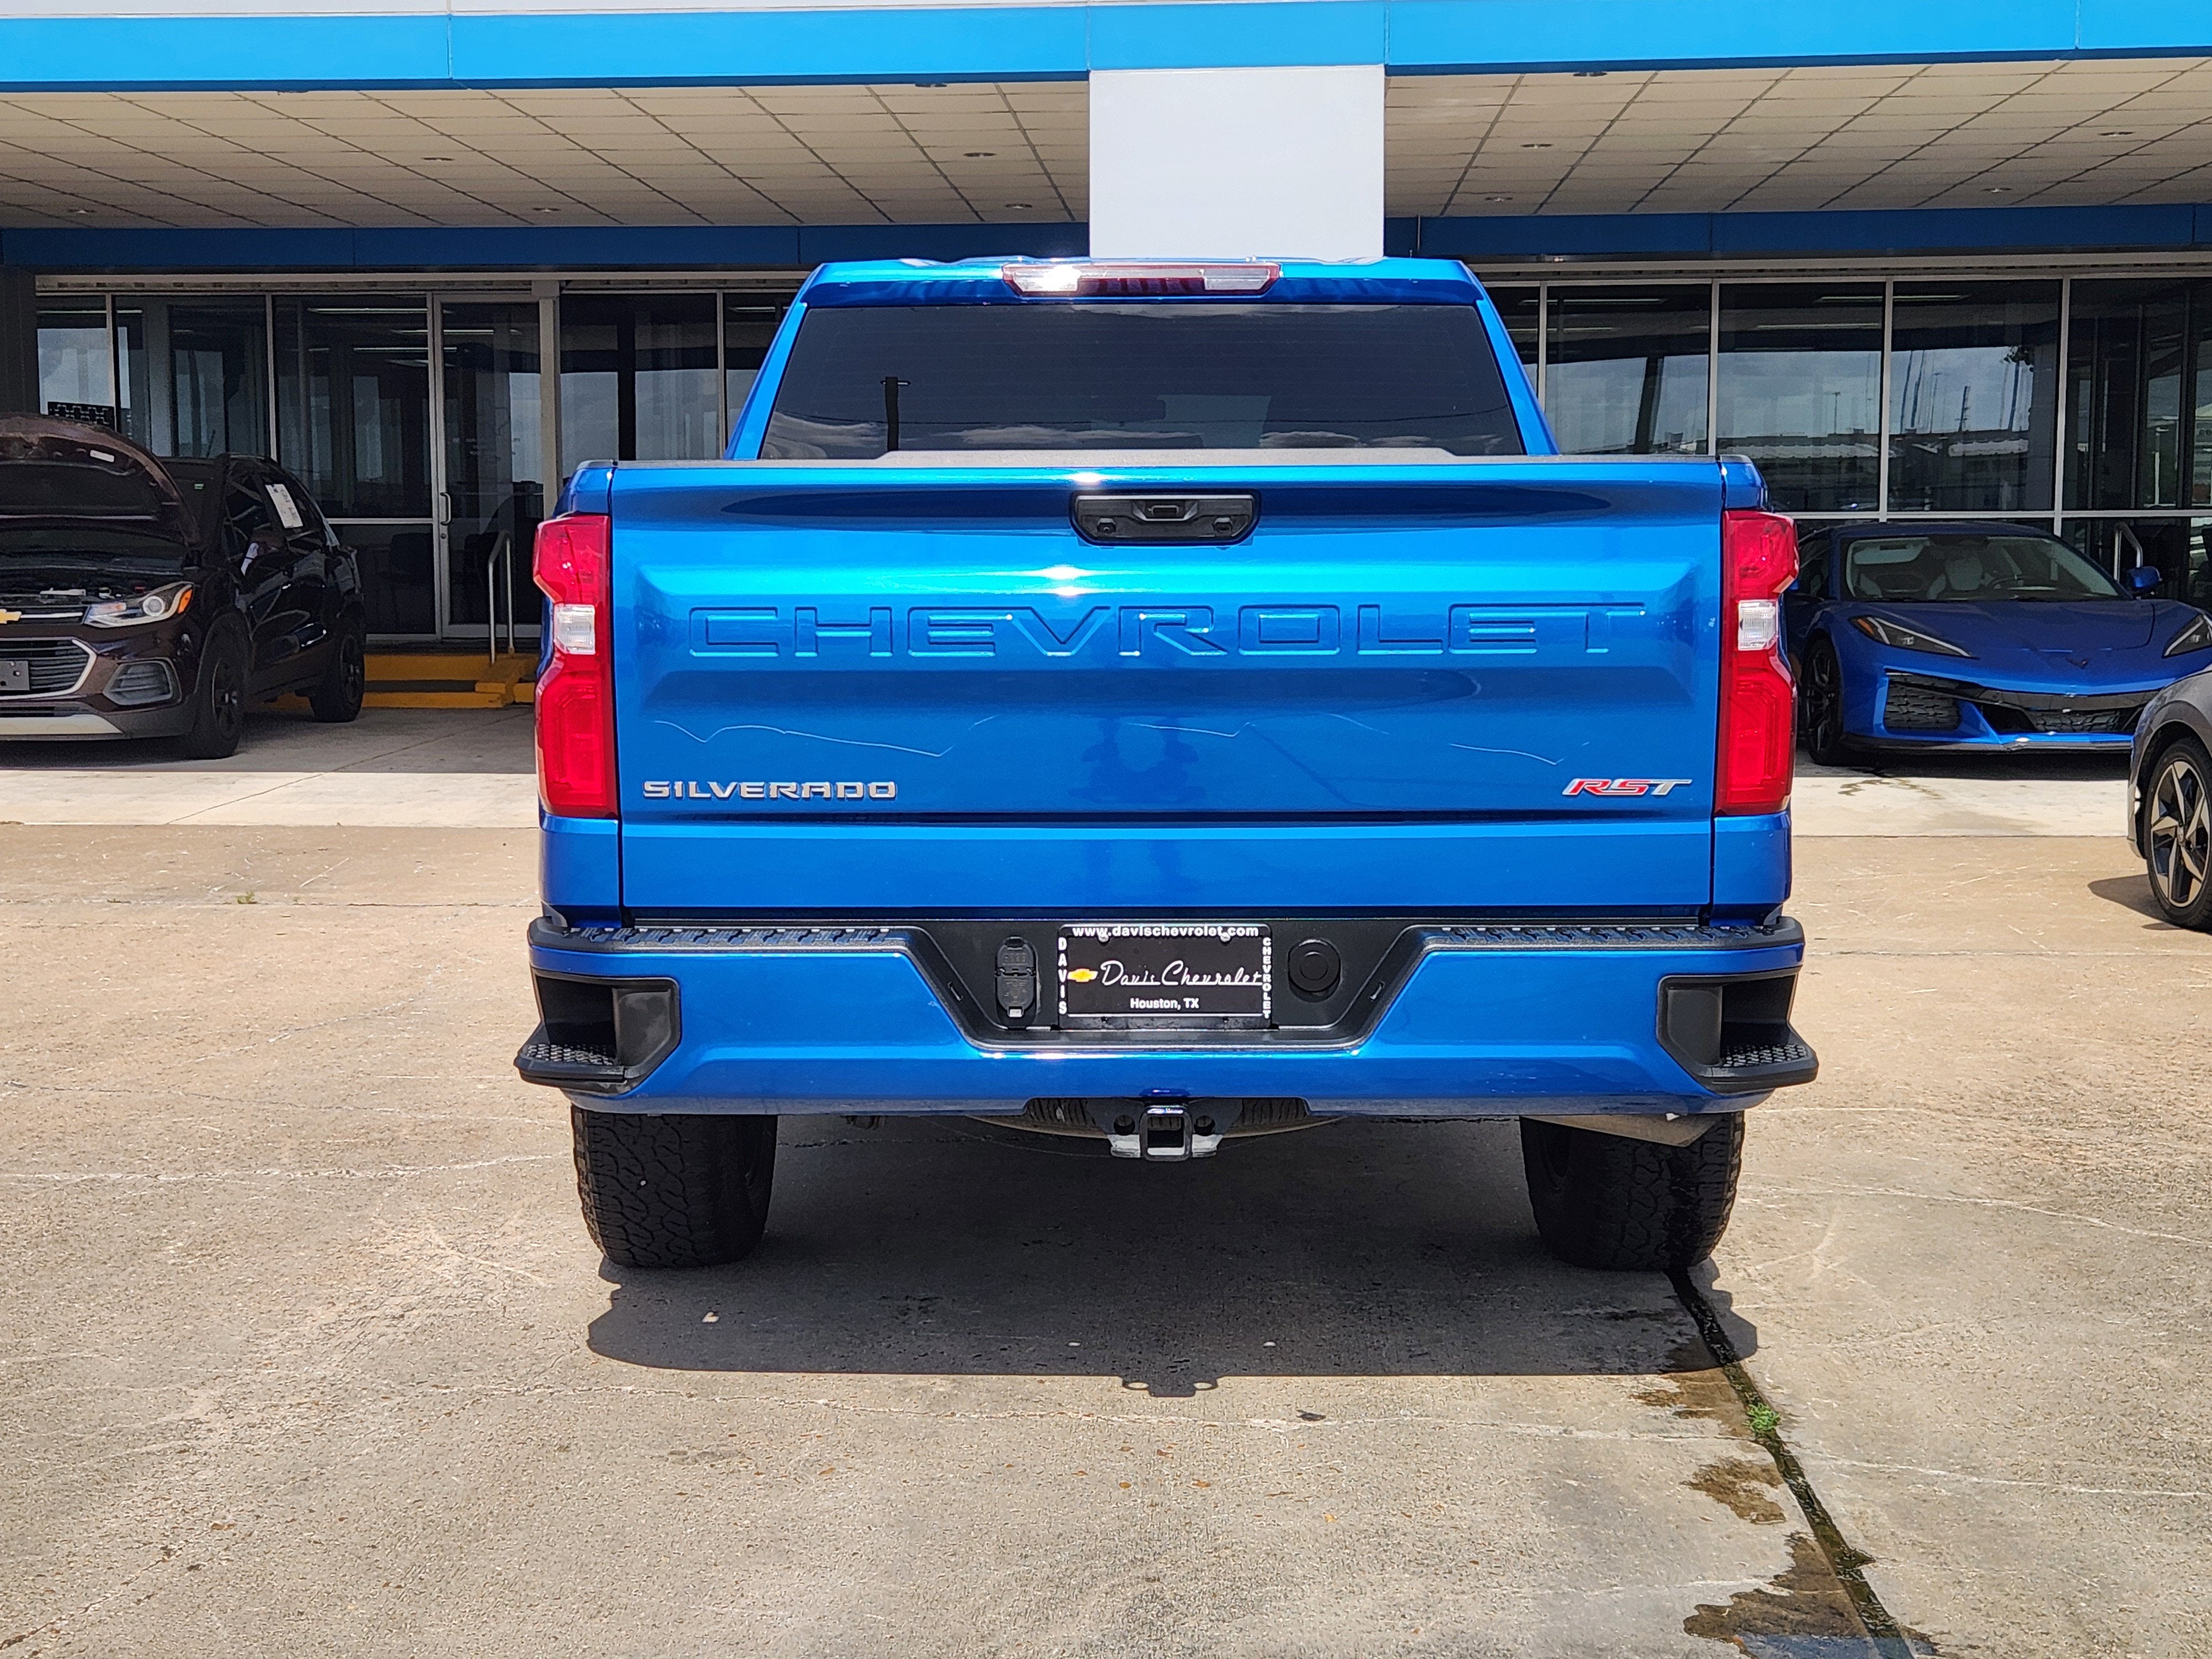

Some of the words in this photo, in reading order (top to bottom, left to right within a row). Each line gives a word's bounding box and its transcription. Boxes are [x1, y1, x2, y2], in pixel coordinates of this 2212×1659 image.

[688, 602, 1646, 658] CHEVROLET
[642, 780, 897, 799] SILVERADO
[1562, 778, 1693, 795] RST
[1058, 937, 1068, 1015] DAVIS
[1100, 959, 1161, 986] Davis
[1161, 959, 1262, 986] Chevrolet
[1262, 937, 1272, 1019] CHEVROLET
[1130, 998, 1181, 1010] Houston,
[1183, 998, 1199, 1009] TX
